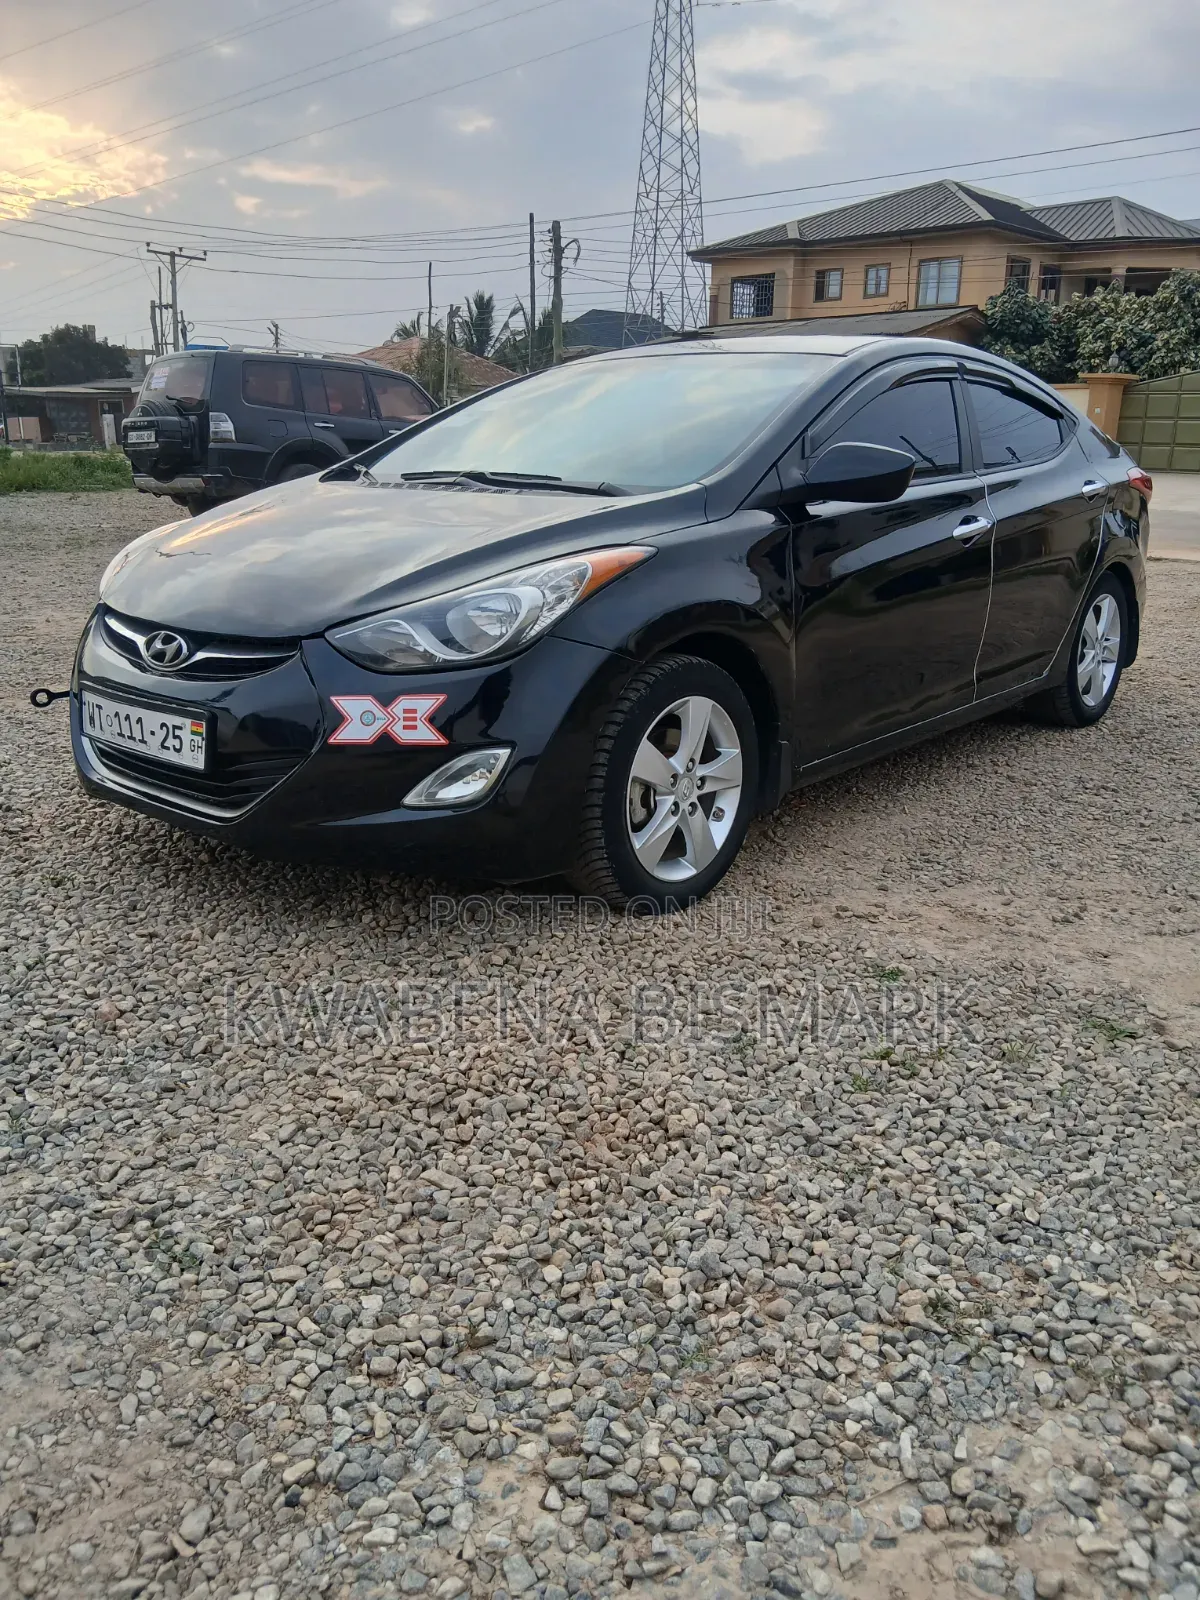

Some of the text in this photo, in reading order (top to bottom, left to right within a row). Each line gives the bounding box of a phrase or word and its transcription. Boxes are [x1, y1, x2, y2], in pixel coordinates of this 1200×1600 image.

[87, 700, 204, 755] WT 111-25 GH
